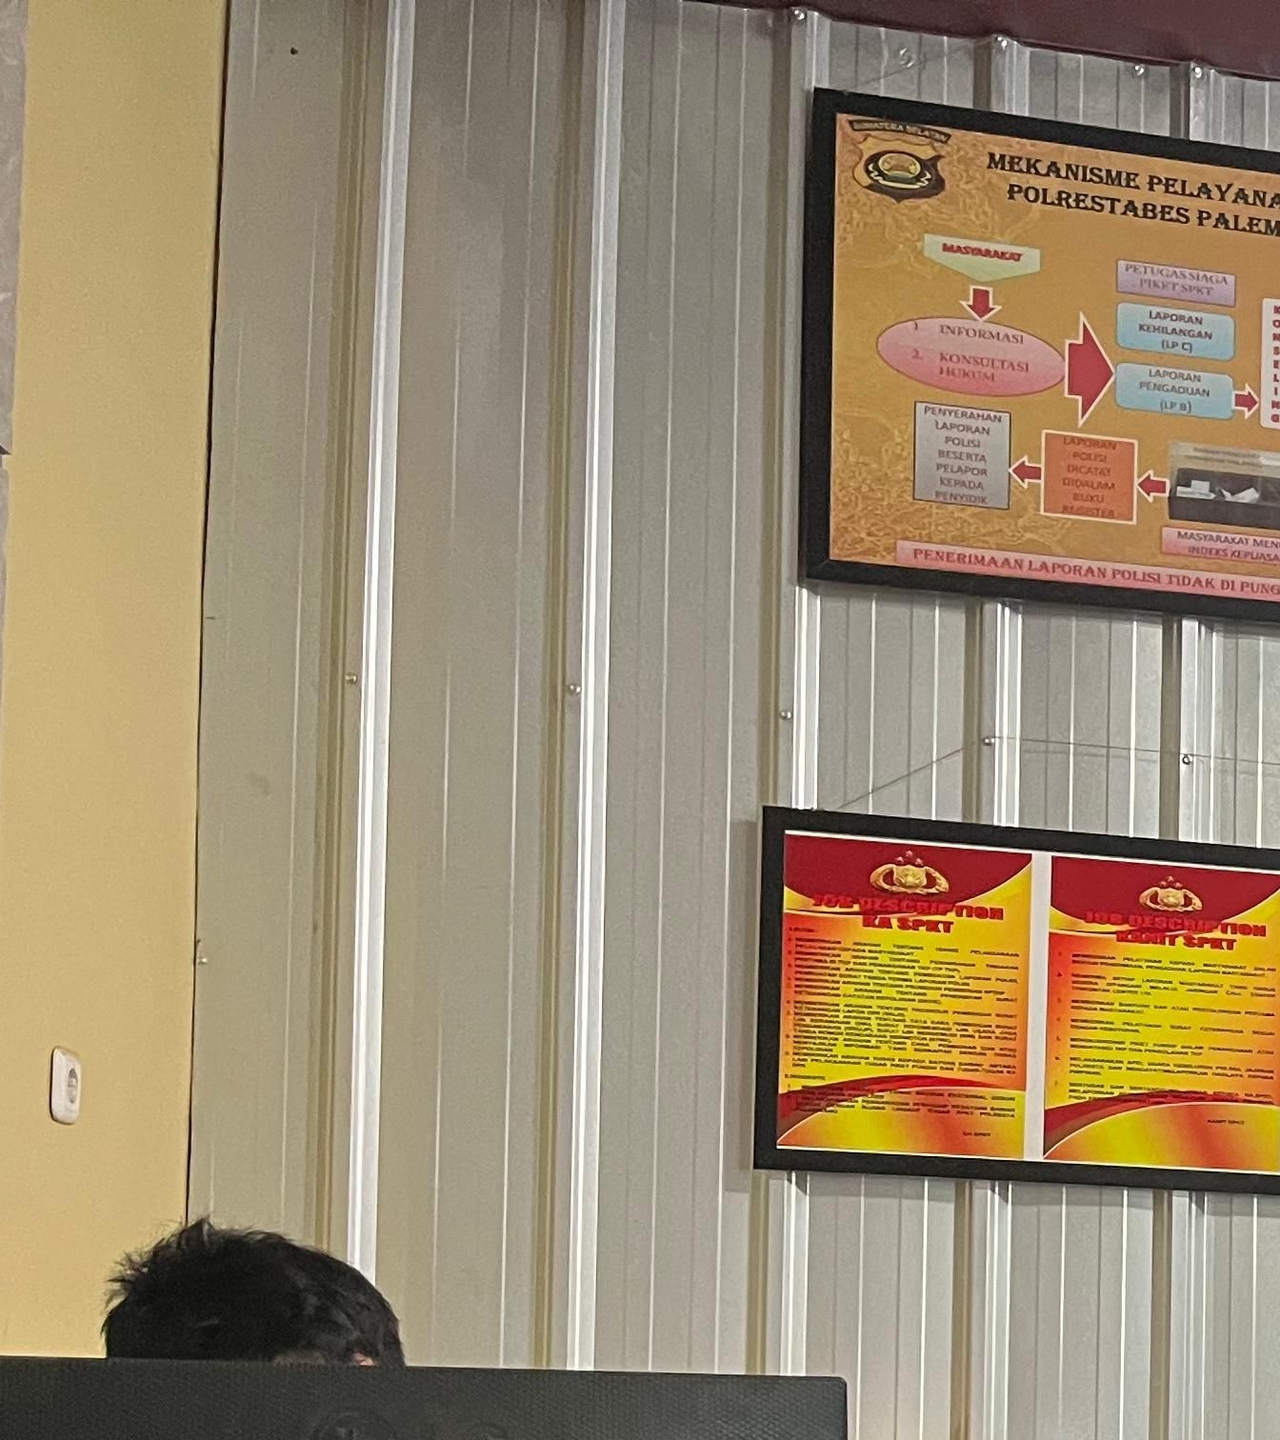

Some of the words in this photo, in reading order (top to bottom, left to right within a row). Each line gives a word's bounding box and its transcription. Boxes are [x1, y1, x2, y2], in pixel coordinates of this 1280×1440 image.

[987, 152, 1141, 190] MEKANISME
[1007, 183, 1191, 225] POLRESTABES
[942, 242, 1023, 263] MASYARAKAT
[1125, 263, 1187, 280] PETUGAS
[1188, 272, 1229, 286] SIAGA
[1139, 278, 1177, 292] PIKET
[1182, 283, 1214, 297] SPKT
[1148, 310, 1204, 326] LAPORAN
[939, 323, 1025, 345] INFORMASI
[1138, 323, 1214, 340] KEHILANGAN
[1161, 339, 1179, 351] (LP
[939, 351, 1030, 373] KONSULTASI
[938, 366, 996, 383] HUKUM
[1148, 368, 1202, 383] LAPORAN
[1138, 381, 1211, 397] PENGADUAN
[923, 405, 1003, 423] PENYERAHAN
[1160, 400, 1178, 412] (LP
[933, 419, 991, 436] LAPORAN
[944, 435, 981, 448] POLISI
[1062, 436, 1117, 451] LAPORAN
[937, 448, 987, 463] BESERTA
[936, 462, 988, 477] PELAPOR
[939, 476, 984, 490] KEPADA
[934, 491, 986, 505] PENYIDIK
[1176, 530, 1250, 546] MASYARAKAT
[1187, 546, 1229, 558] INDEKS
[912, 547, 1024, 571] PENERIMAAN
[1027, 559, 1107, 580] LAPORAN
[1111, 567, 1162, 585] POLISI
[1167, 573, 1217, 590] TIDAK
[1220, 580, 1236, 592] DI
[812, 893, 854, 908] JOB
[857, 896, 1004, 921] DESCRIPTION
[862, 914, 893, 930] KA
[896, 917, 954, 934] SPKT
[1083, 910, 1124, 925] JOB
[1127, 913, 1267, 938] DESCRIPTION
[1182, 933, 1238, 951] SPKT
